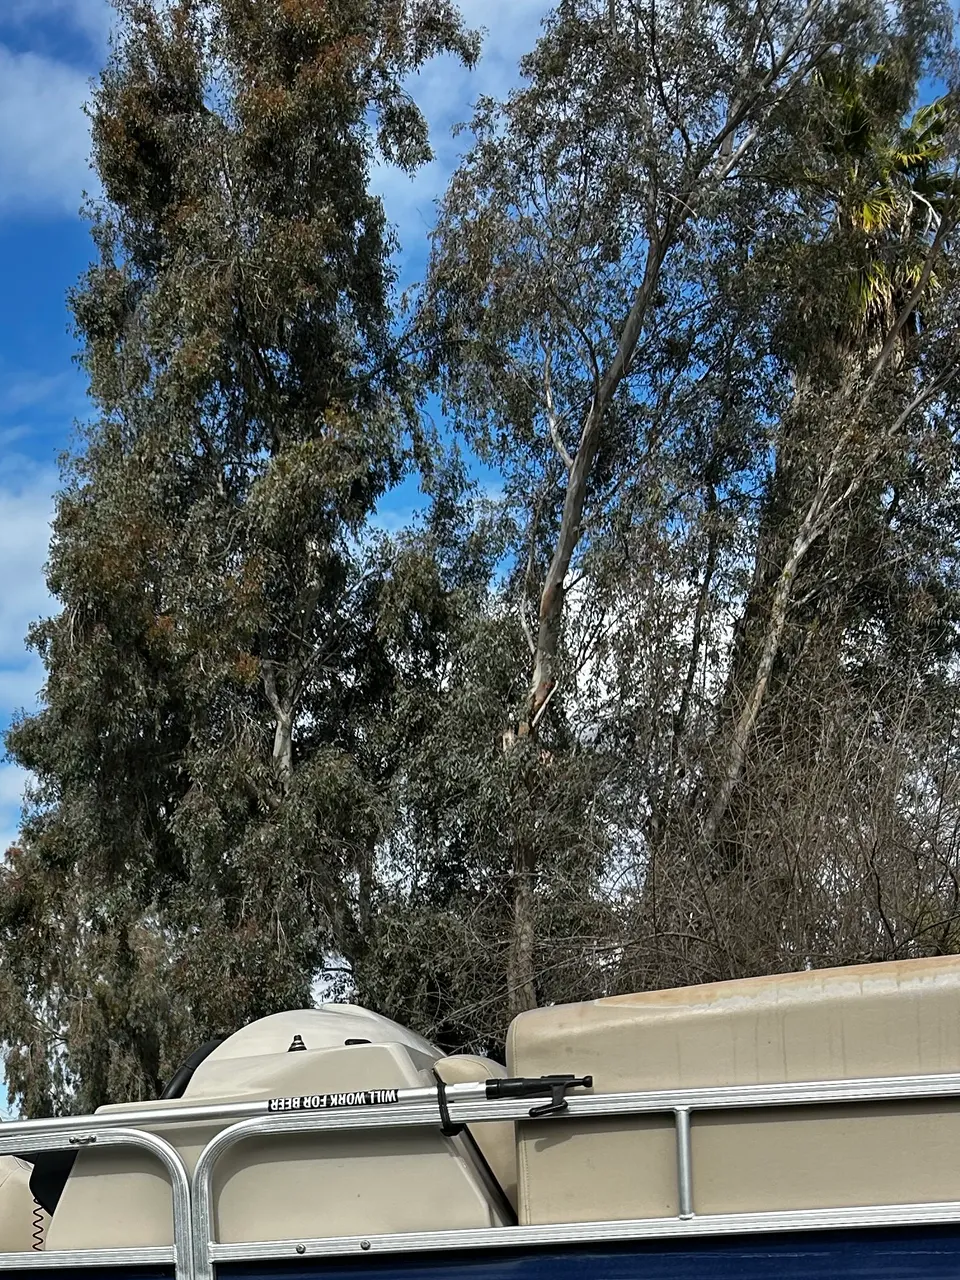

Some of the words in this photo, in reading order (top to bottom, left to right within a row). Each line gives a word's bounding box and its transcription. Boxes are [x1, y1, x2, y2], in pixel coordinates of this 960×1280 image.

[303, 1095, 327, 1108] FOR
[330, 1092, 366, 1106] WORK
[368, 1089, 397, 1104] WILL
[270, 1097, 301, 1111] BEER
